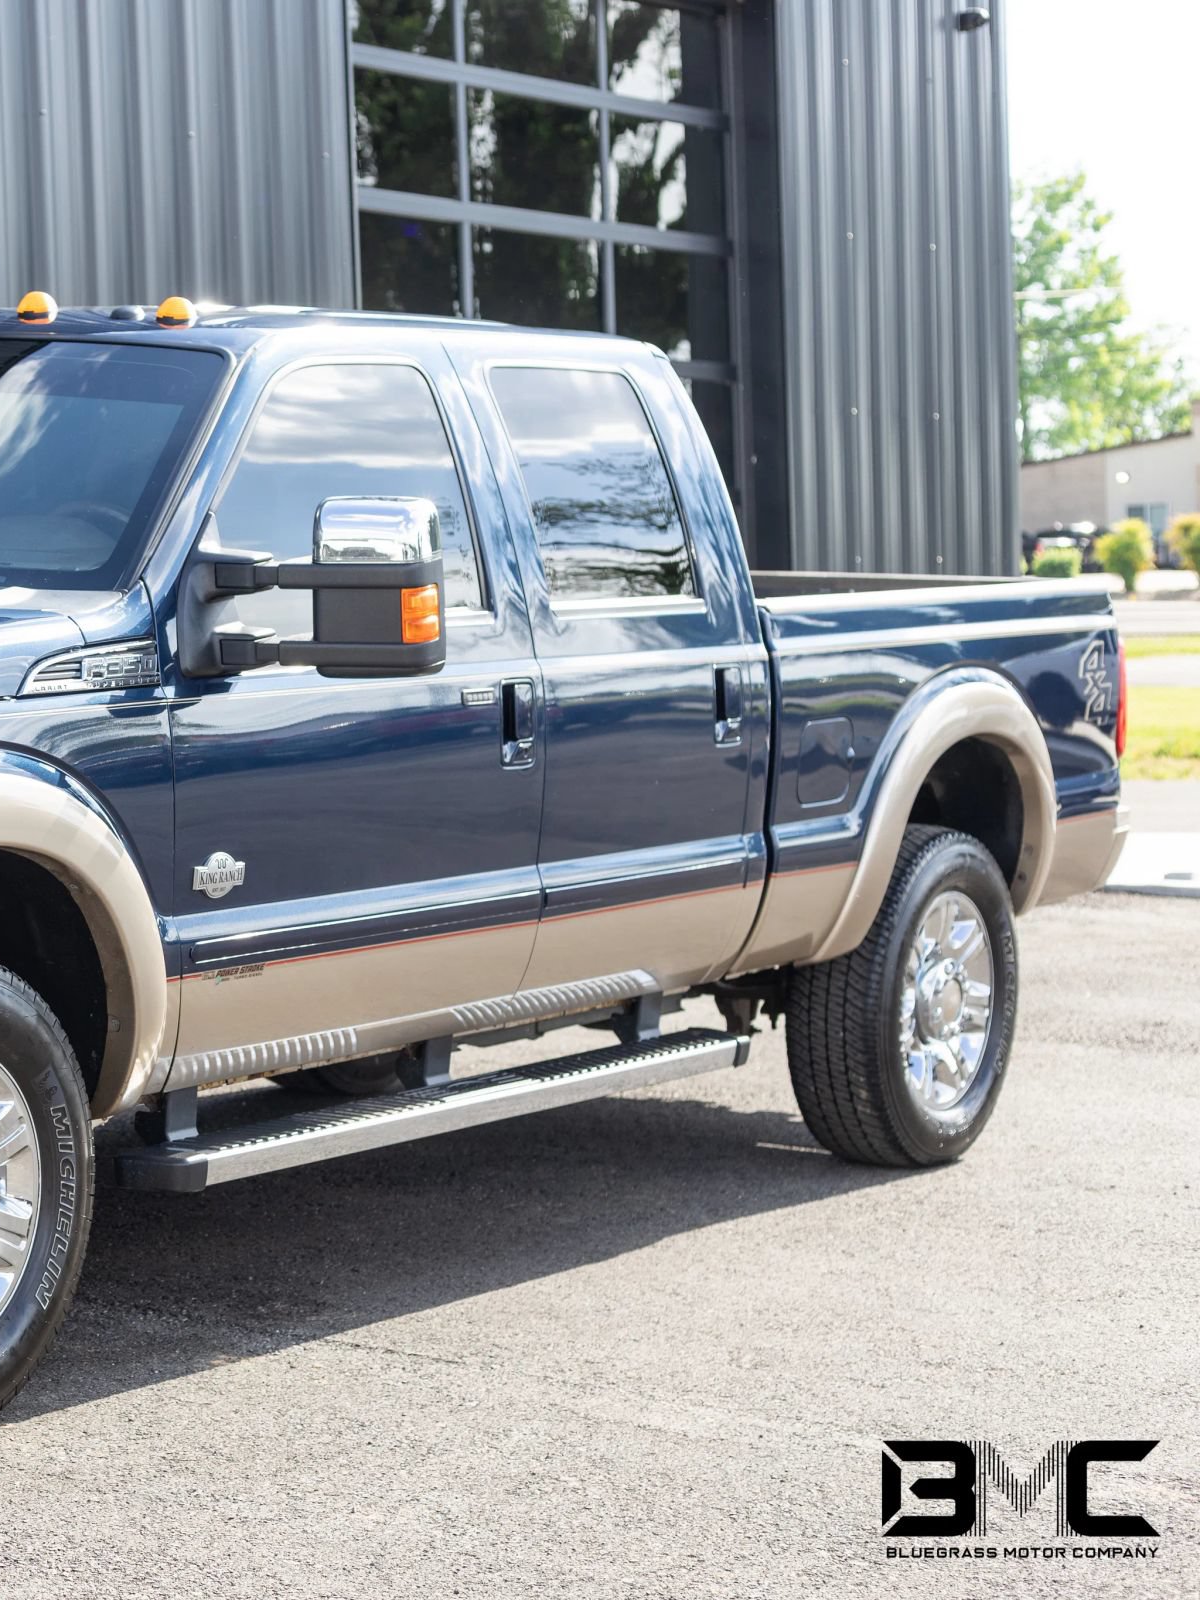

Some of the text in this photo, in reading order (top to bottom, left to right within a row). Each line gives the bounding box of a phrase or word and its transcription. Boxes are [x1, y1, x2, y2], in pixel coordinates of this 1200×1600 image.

[200, 867, 243, 885] KING RANCH
[216, 967, 240, 977] POWER
[239, 963, 265, 974] STROKE
[35, 1104, 77, 1310] MICHELIN
